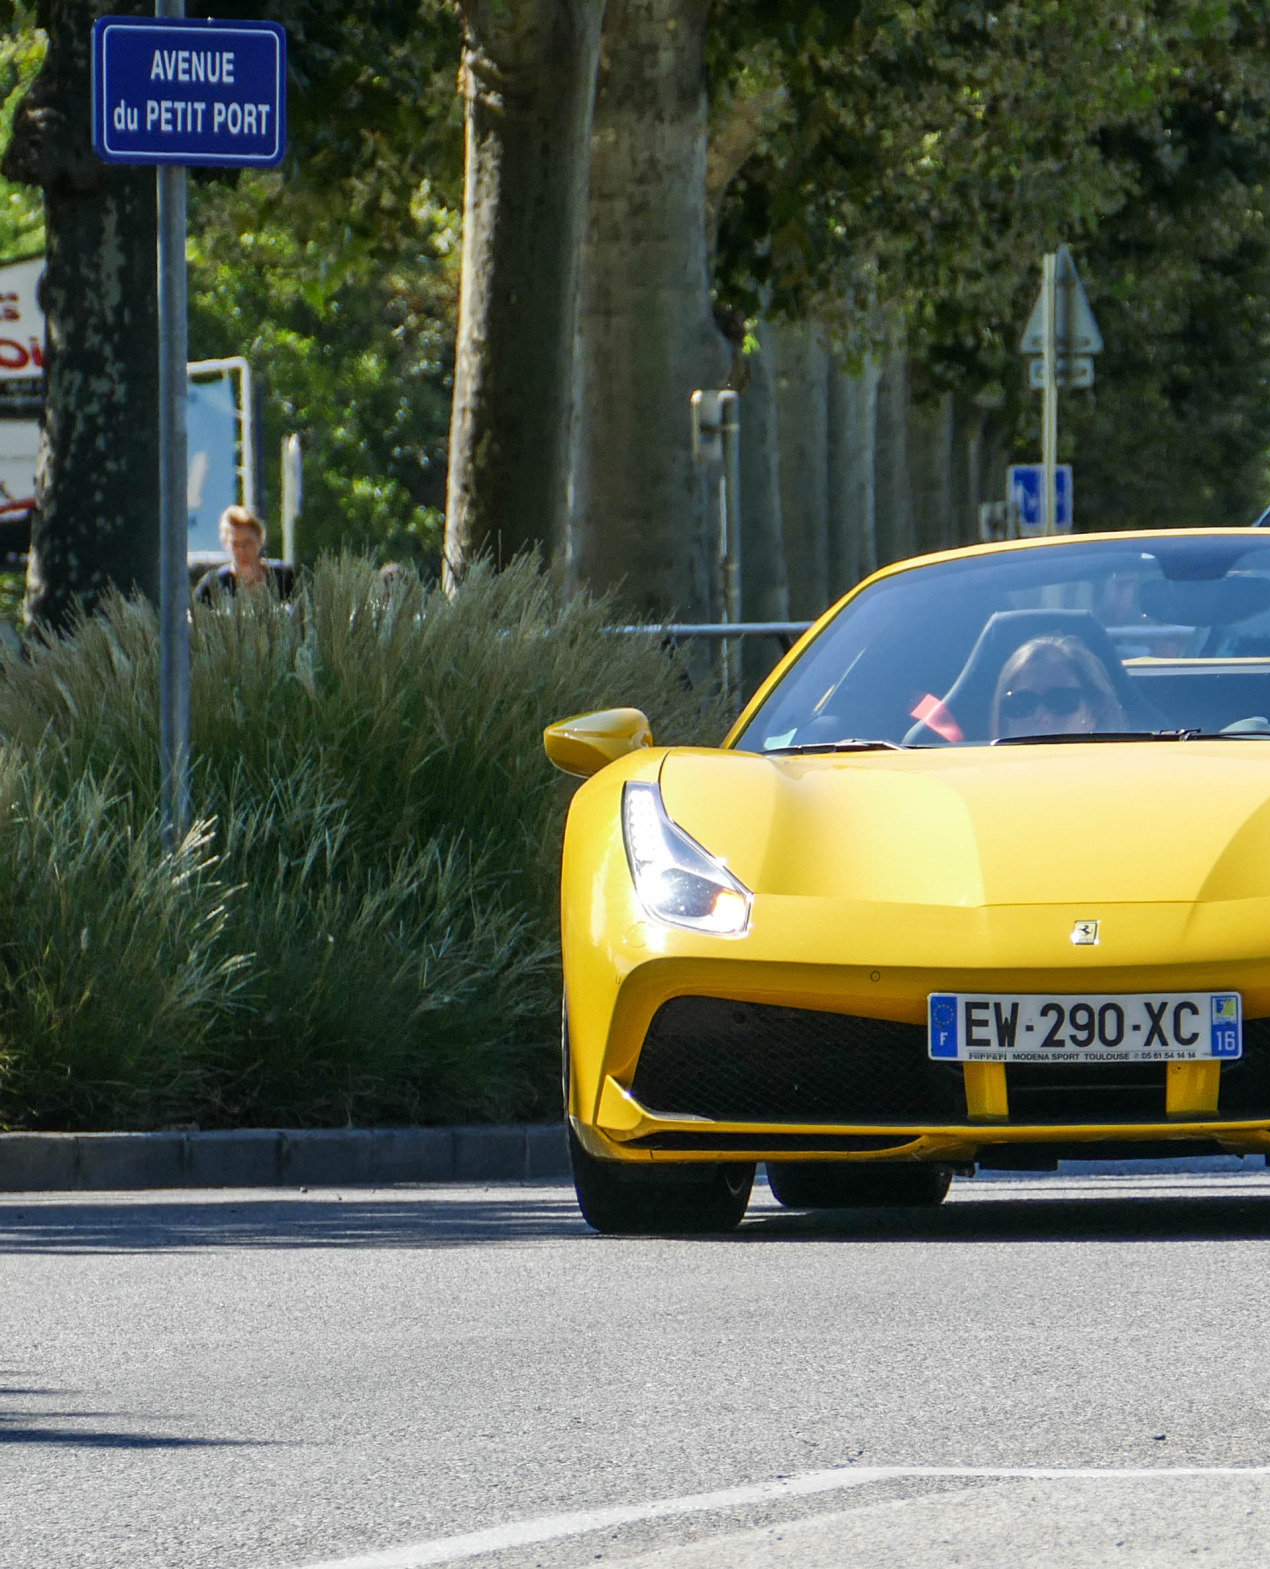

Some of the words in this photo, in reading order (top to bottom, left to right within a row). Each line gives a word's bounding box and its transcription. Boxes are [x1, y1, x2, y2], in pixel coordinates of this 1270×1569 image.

[151, 49, 234, 84] AVENUE
[114, 99, 138, 128] du
[146, 99, 206, 134] PETIT
[213, 101, 271, 137] PORT
[965, 1001, 1200, 1048] EW-290-XC
[939, 1032, 948, 1046] F
[1215, 1030, 1236, 1051] 16
[1085, 1053, 1130, 1061] TOULOUSE
[1141, 1052, 1151, 1060] 05
[1164, 1052, 1174, 1060] 54
[1176, 1052, 1185, 1060] 14
